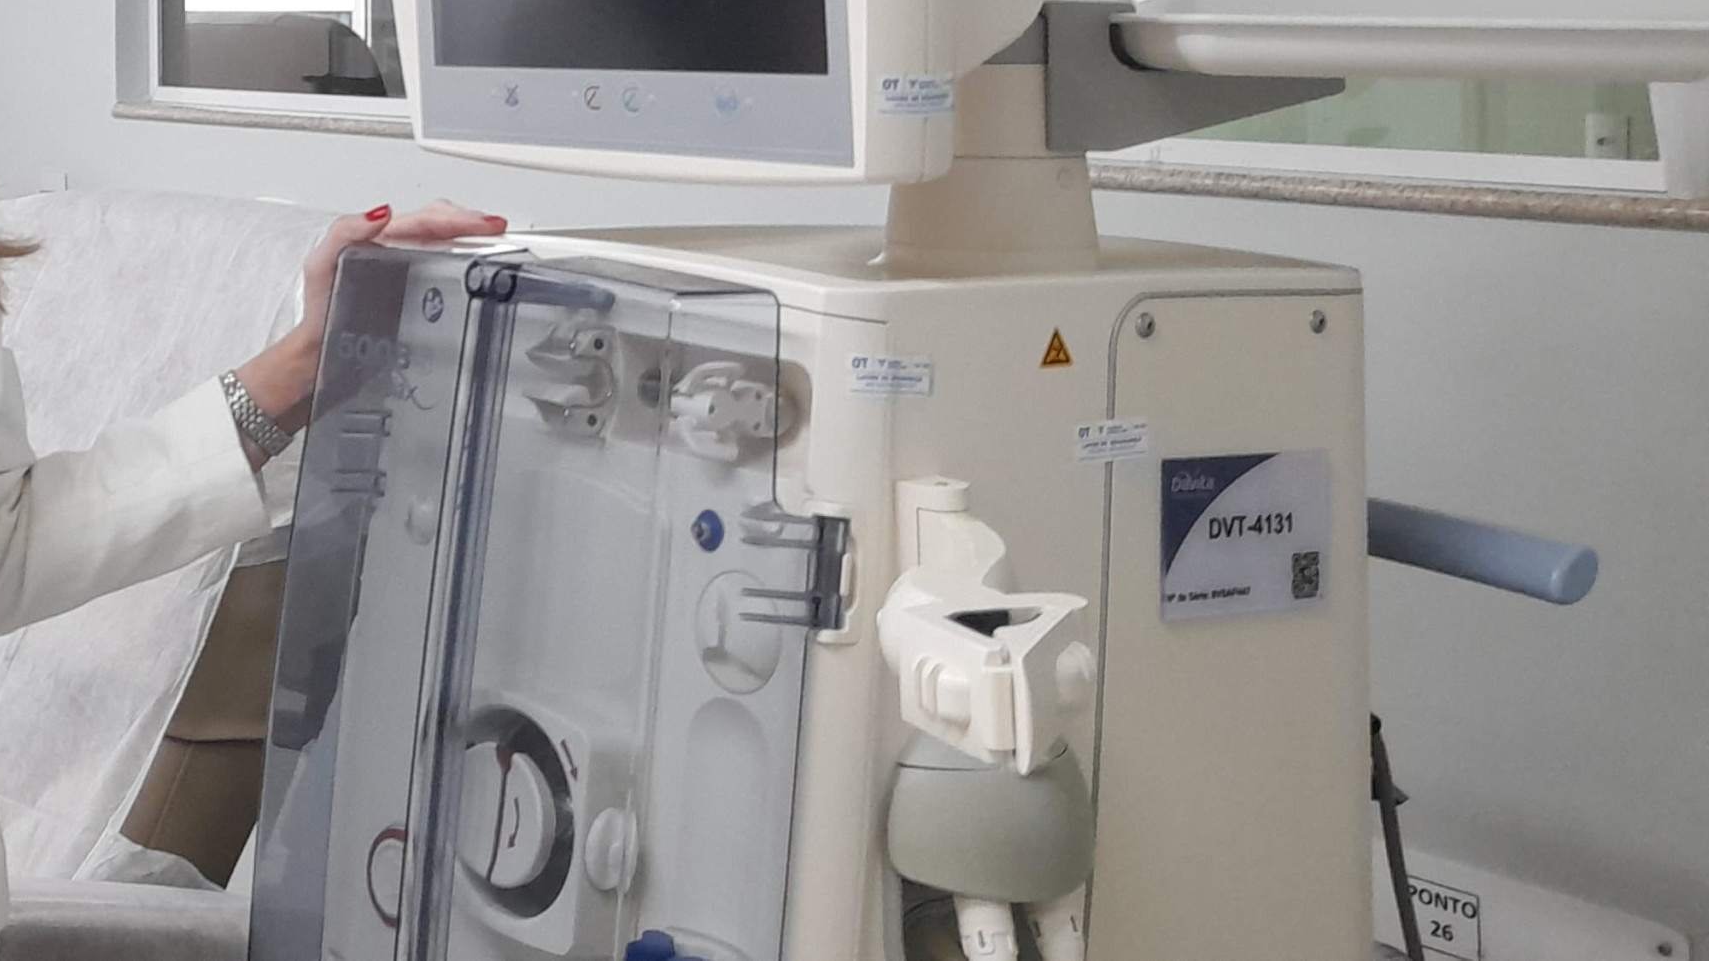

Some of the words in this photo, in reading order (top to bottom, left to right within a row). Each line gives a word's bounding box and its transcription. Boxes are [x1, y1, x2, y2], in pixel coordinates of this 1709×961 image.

[1209, 512, 1293, 539] DVT-4131
[1407, 884, 1477, 919] PONTO
[1430, 920, 1454, 941] 26
